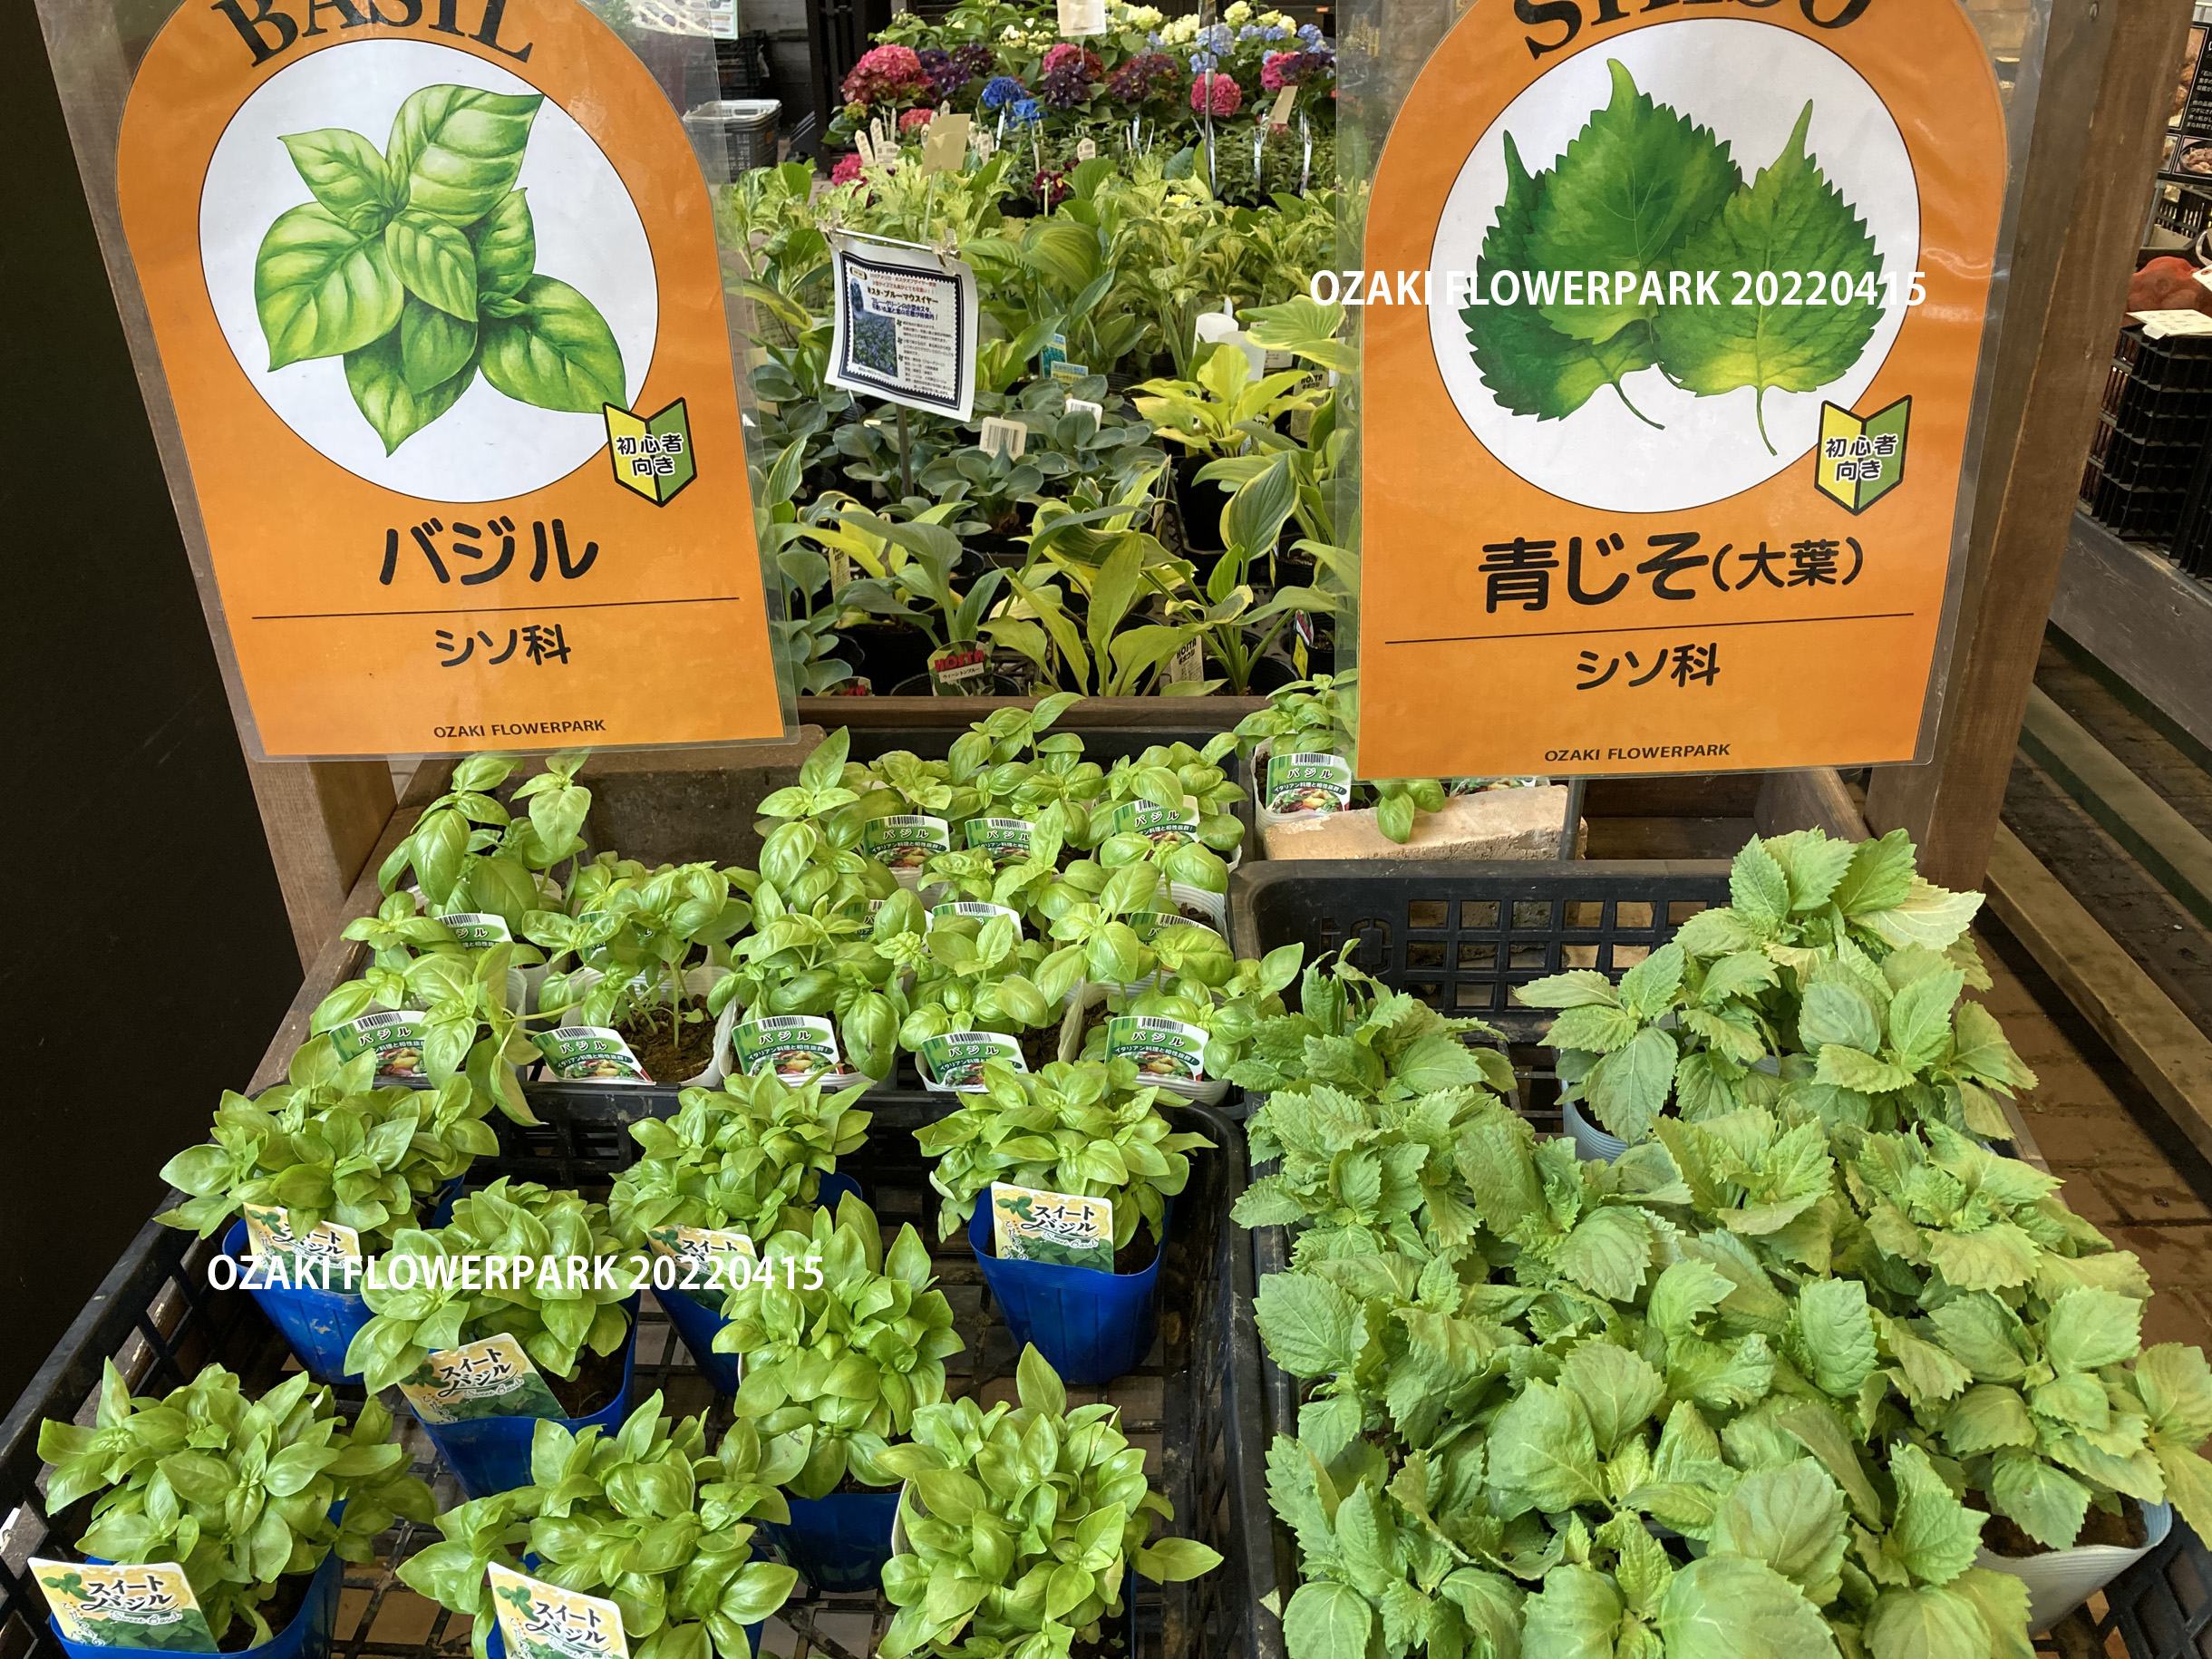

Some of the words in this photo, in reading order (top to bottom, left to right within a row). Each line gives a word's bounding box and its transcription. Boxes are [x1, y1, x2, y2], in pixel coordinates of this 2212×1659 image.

[616, 434, 683, 455] 初心者
[1825, 434, 1897, 458] 初心者
[633, 456, 675, 477] 向き
[1836, 459, 1882, 481] 向き
[380, 516, 599, 585] バジル
[436, 624, 571, 667] シソ科
[935, 650, 985, 673] HOSTA
[1576, 642, 1721, 691] シソ科
[433, 724, 485, 739] OZAKI
[491, 719, 606, 737] FLOWERPARK
[1545, 748, 1600, 762] OZAKI
[1607, 743, 1732, 761] FLOWERPARK
[1287, 768, 1333, 779] バジル
[1135, 810, 1179, 827] バジル
[883, 829, 930, 839] バジル
[986, 830, 1030, 841] バジル
[456, 927, 488, 939] ジル
[358, 1027, 412, 1046] バジル
[759, 1031, 811, 1044] バジル
[1131, 1032, 1185, 1047] バジル
[559, 1040, 607, 1053] バジル
[948, 1045, 1000, 1057] バジル
[1033, 1206, 1095, 1220] スイート
[1021, 1218, 1097, 1234] バジル
[682, 1239, 738, 1253] スイート
[440, 1348, 502, 1380] スイート
[438, 1363, 512, 1397] バジル
[88, 1575, 164, 1596] スイート
[81, 1594, 174, 1612] バジル
[536, 1601, 601, 1627] スイート
[525, 1620, 607, 1644] バジル
